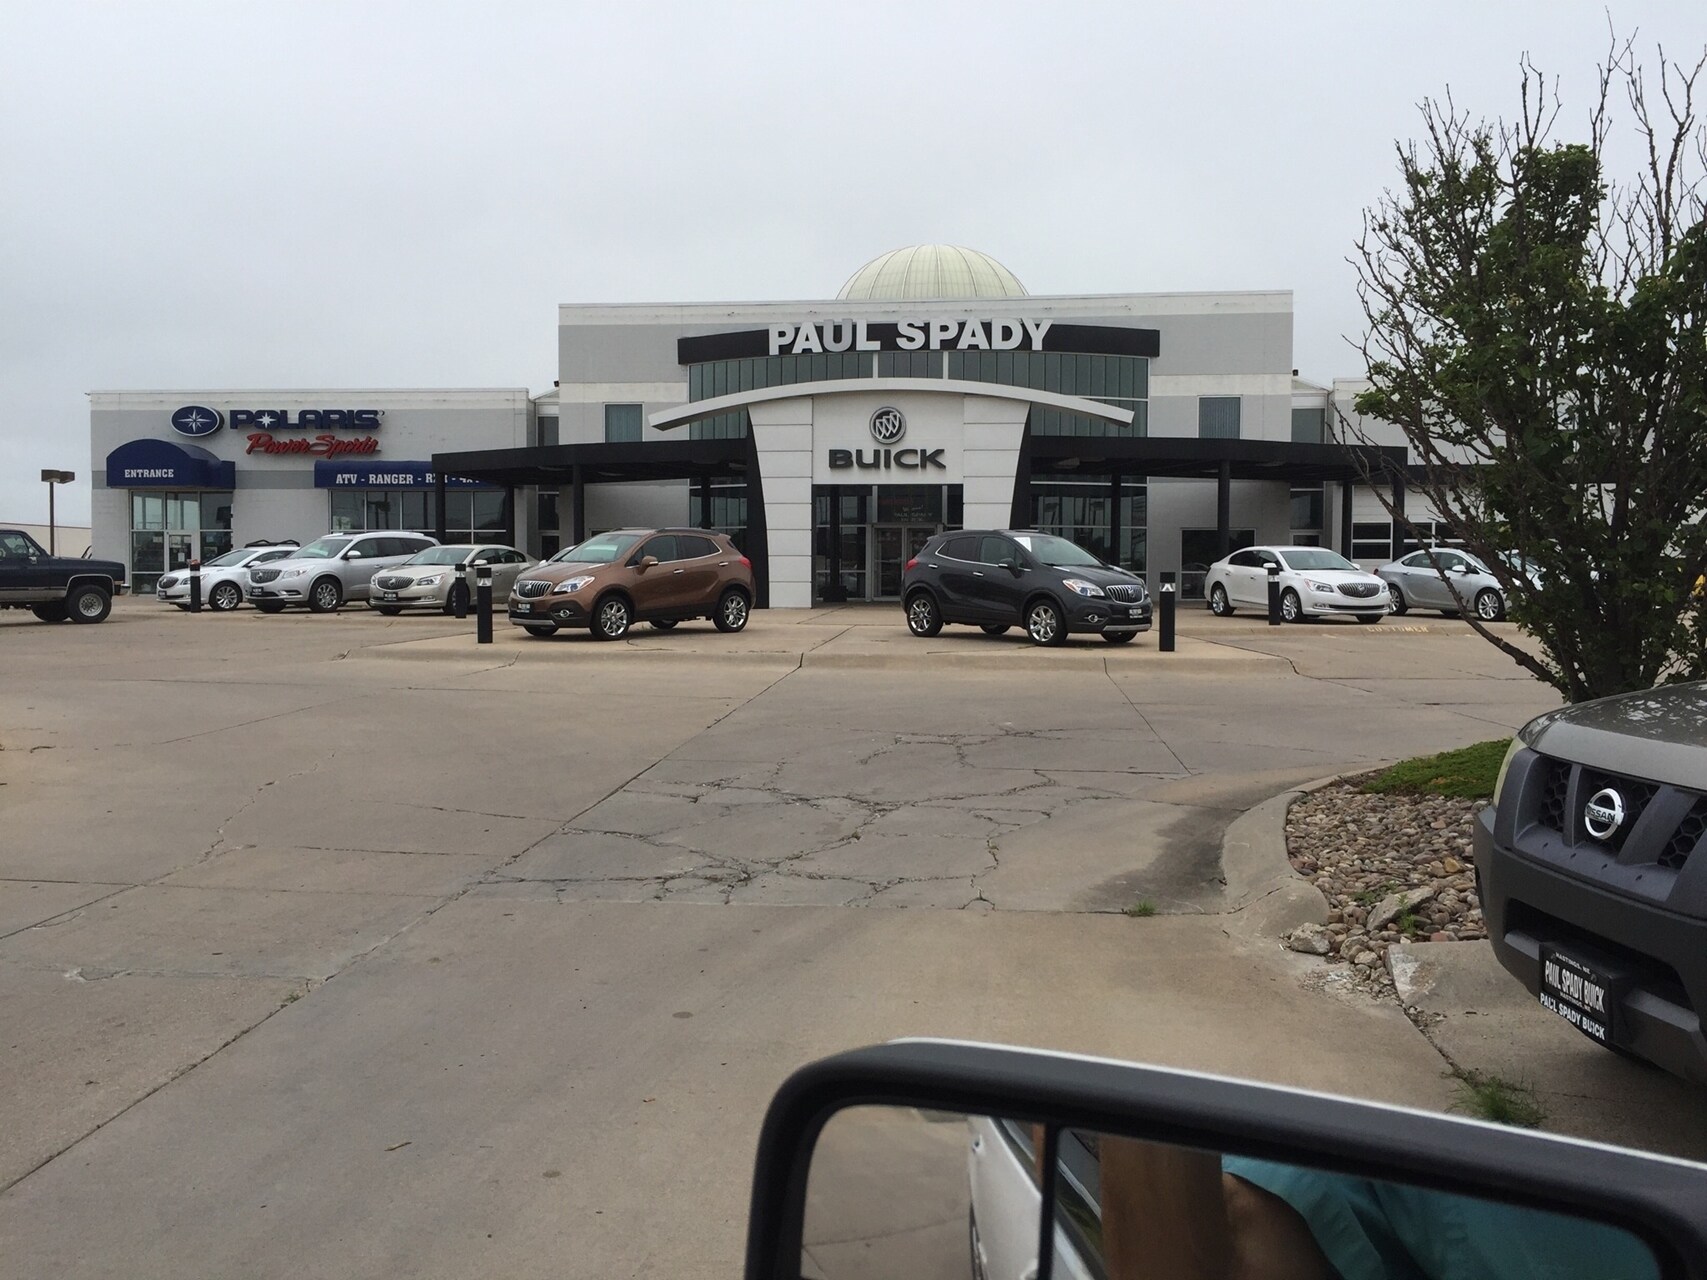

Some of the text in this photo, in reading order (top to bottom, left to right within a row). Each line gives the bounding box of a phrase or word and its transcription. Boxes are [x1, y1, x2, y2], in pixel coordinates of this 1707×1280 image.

[769, 317, 1054, 355] PAUL SPADY
[230, 410, 381, 430] POLARIS
[829, 448, 946, 469] BUICK
[124, 469, 175, 479] ENTRANCE
[336, 474, 357, 484] ATV
[369, 474, 414, 484] RANGER
[1545, 960, 1605, 1013] PAUL SPADY BUICK
[1540, 992, 1605, 1040] PAUL SPADY BUICK
